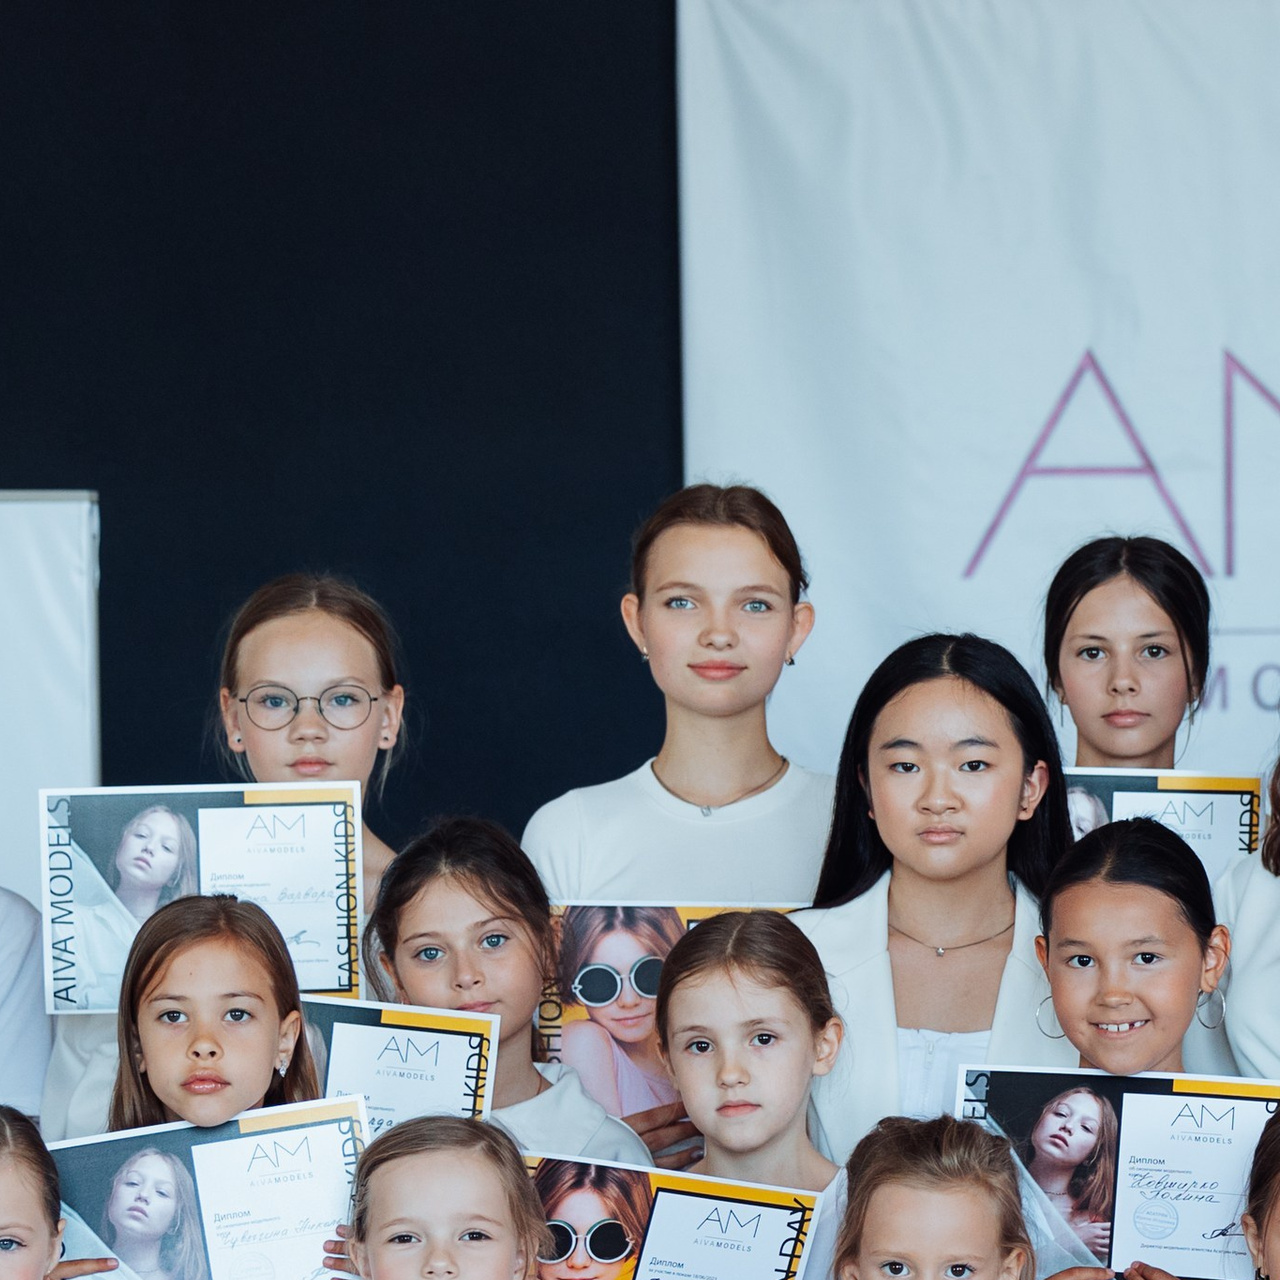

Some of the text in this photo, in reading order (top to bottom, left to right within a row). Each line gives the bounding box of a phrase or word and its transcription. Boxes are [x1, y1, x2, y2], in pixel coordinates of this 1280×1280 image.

[1159, 801, 1213, 825] AM
[1239, 794, 1260, 854] KIDS
[246, 814, 305, 839] AM
[47, 796, 77, 1004] AIVA MODELS
[333, 804, 360, 989] FASHION KIDS
[377, 1036, 440, 1067] AM
[376, 1069, 435, 1082] AIVAMODELS
[463, 1036, 491, 1098] KIDS
[1171, 1103, 1235, 1130] AM
[1170, 1134, 1233, 1145] AIVAMODELS
[247, 1136, 311, 1172] AM
[1129, 1156, 1166, 1165] Диплом
[250, 1172, 314, 1187] AIVAMODELS
[214, 1210, 251, 1222] Диплом
[696, 1207, 761, 1238] AM
[779, 1198, 814, 1259] DAY
[693, 1238, 752, 1253] AIVAMODELS
[649, 1257, 684, 1269] Диплом
